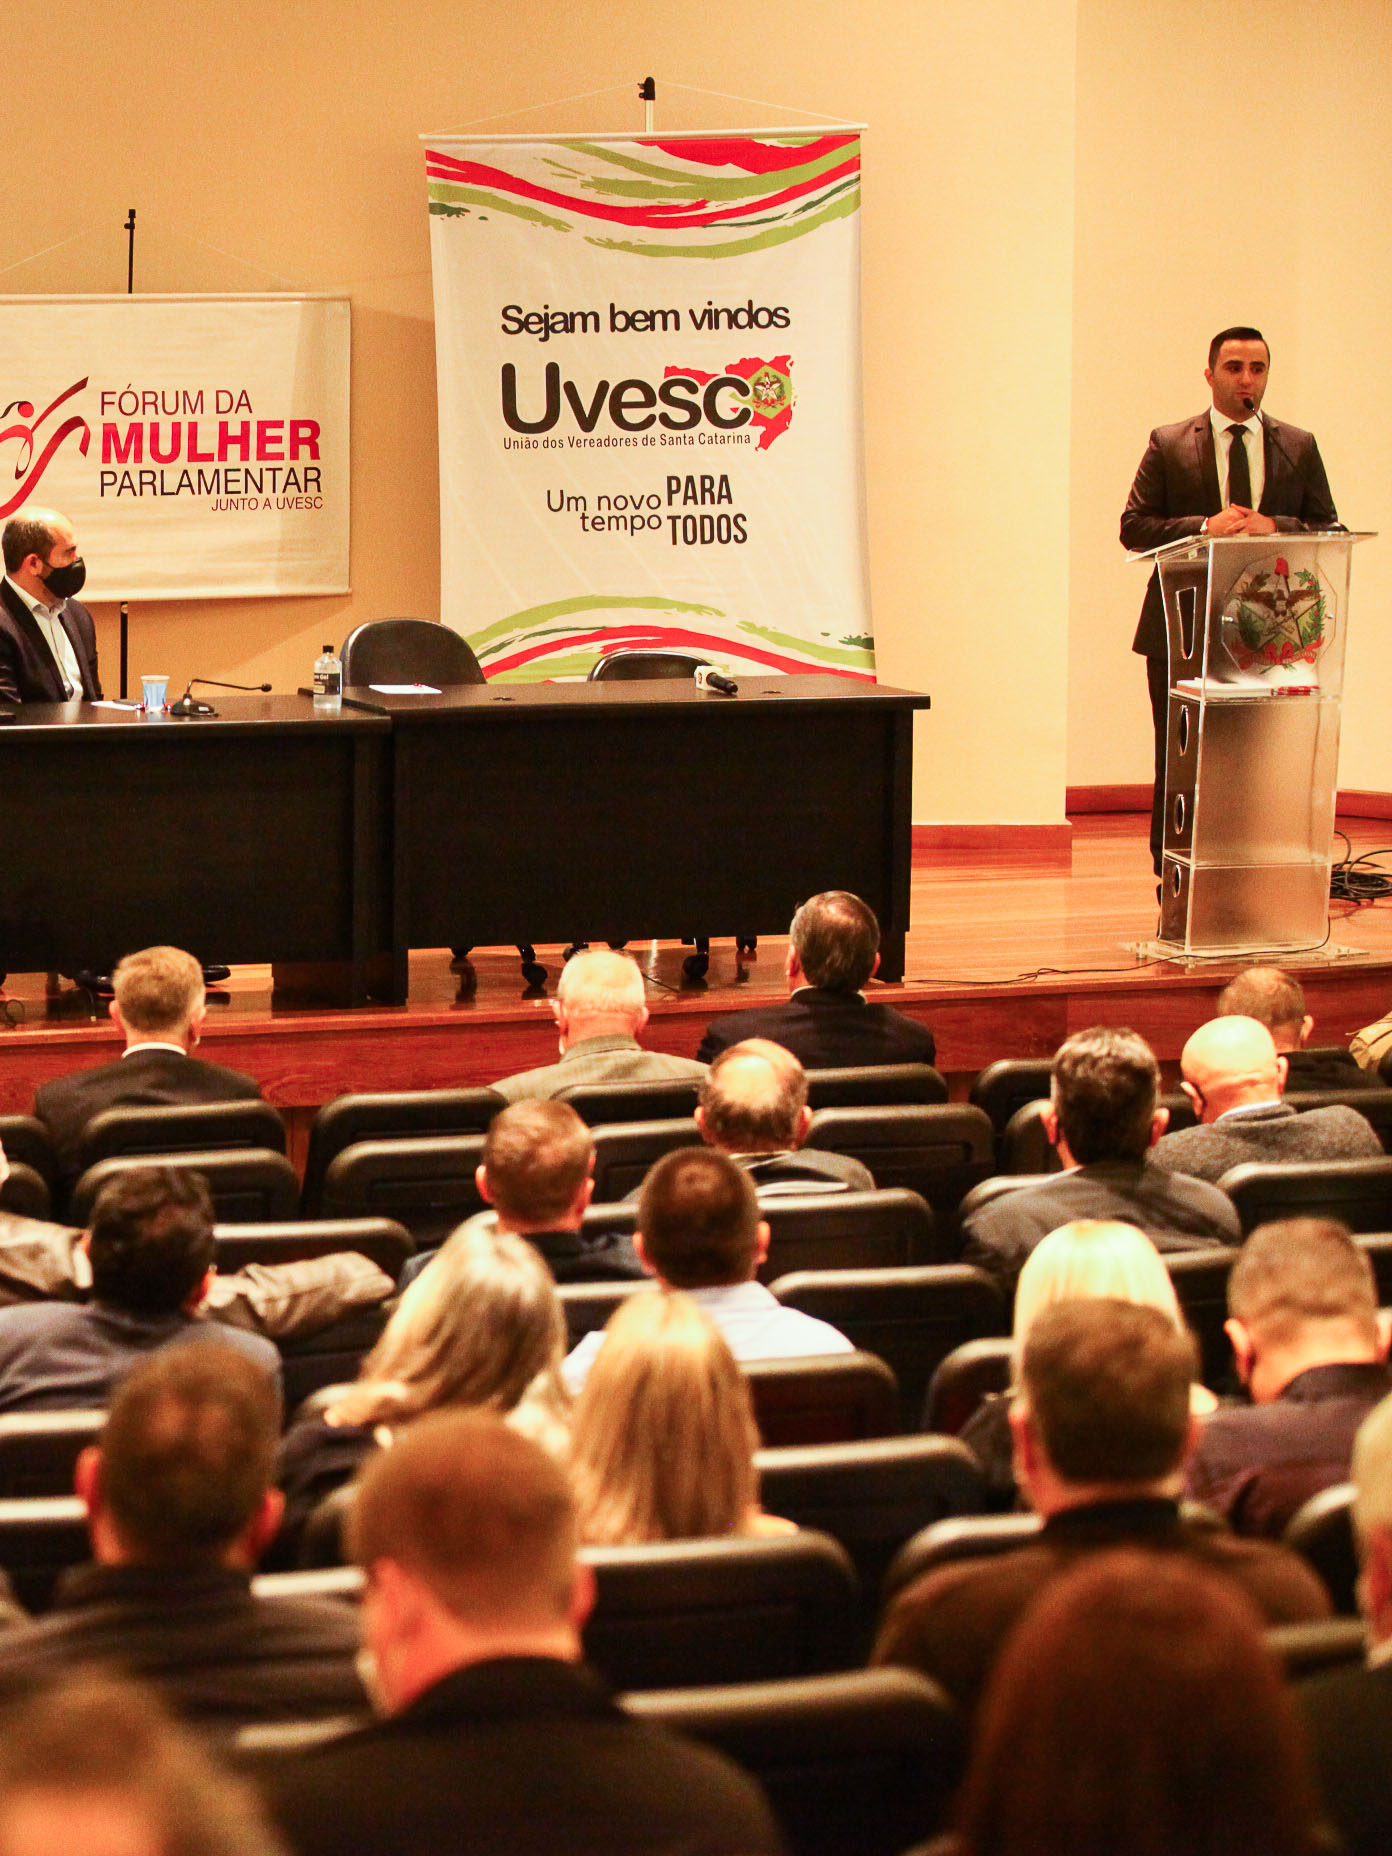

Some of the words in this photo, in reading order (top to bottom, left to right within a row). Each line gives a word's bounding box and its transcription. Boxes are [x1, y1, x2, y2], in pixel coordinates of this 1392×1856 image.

[501, 304, 600, 342] Sejam
[609, 302, 681, 333] bem
[689, 300, 791, 331] vindos
[100, 384, 205, 416] FÓRUM
[215, 389, 253, 415] DA
[501, 361, 752, 434] Uvesc
[101, 419, 321, 464] MULHER
[503, 436, 540, 451] União
[542, 435, 564, 450] dos
[567, 434, 639, 449] Vereadores
[641, 434, 656, 447] de
[659, 432, 695, 446] Santa
[698, 432, 751, 445] Catarina
[100, 466, 323, 498] PARLAMENTAR
[546, 489, 588, 513] Um
[596, 493, 662, 512] novo
[666, 474, 733, 507] PARA
[211, 498, 260, 512] JUNTO
[262, 497, 274, 511] A
[277, 496, 325, 511] UVESC
[580, 512, 663, 537] tempo
[666, 513, 748, 546] TODOS
